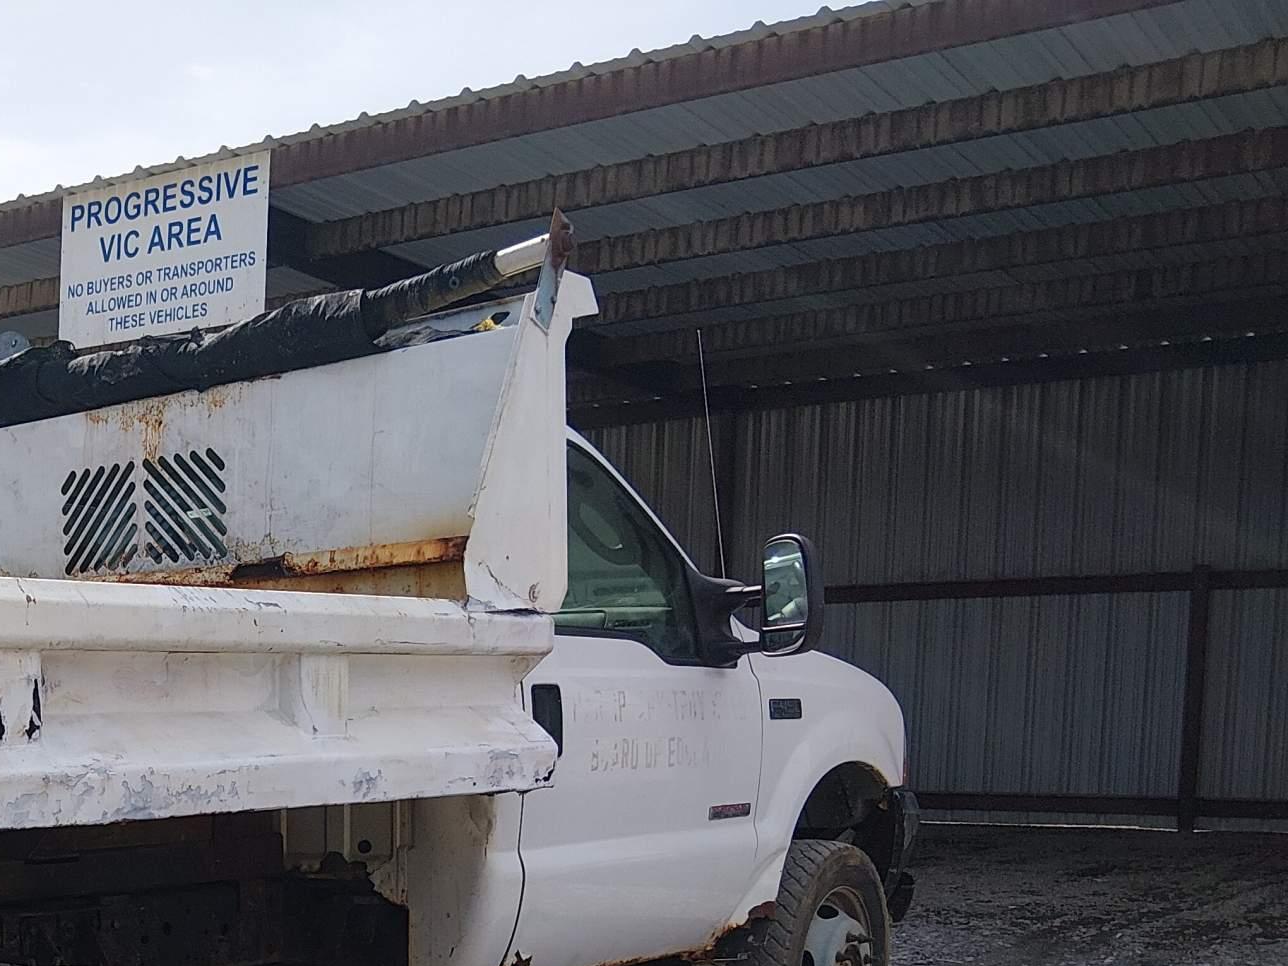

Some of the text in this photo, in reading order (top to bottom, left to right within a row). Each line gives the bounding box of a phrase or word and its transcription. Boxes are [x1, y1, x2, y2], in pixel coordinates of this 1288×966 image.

[70, 165, 259, 232] PROGRESSIVE
[100, 213, 222, 263] VIC AREA
[67, 251, 256, 299] NO BUYERS OR TRANSPORTERS
[86, 276, 234, 315] ALLOWED IN OR AROUND
[108, 302, 208, 332] THESE VEHICLES
